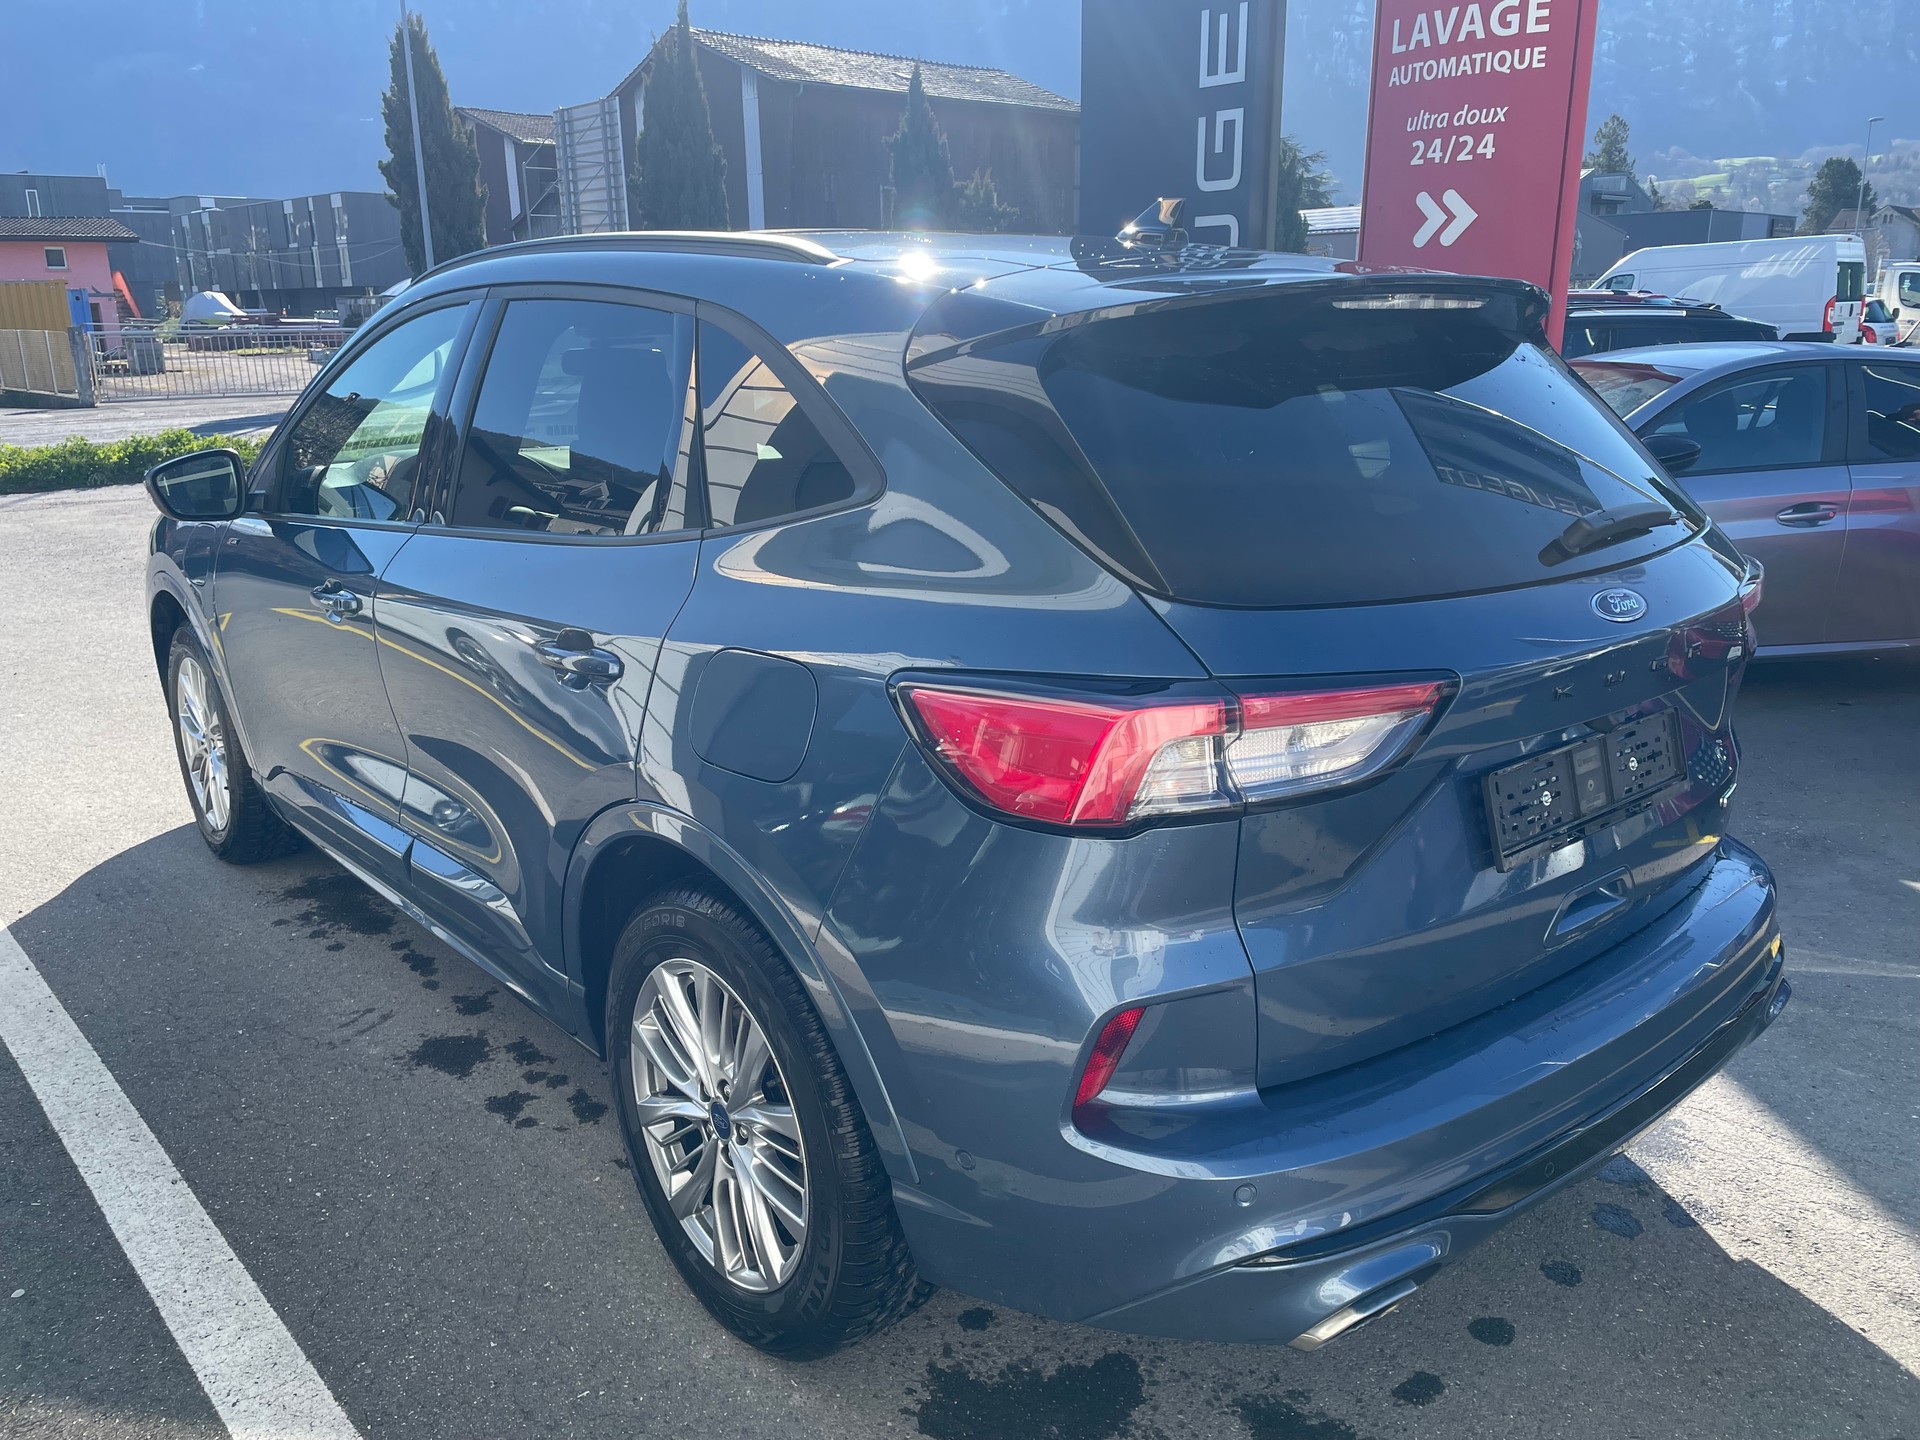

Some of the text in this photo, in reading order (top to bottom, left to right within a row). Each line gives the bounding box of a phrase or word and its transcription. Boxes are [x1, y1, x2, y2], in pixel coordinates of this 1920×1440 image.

[1391, 0, 1551, 54] LAVAGE
[1388, 46, 1547, 87] AUTOMATIQUE
[1406, 104, 1510, 132] ultra doux
[1410, 133, 1496, 166] 24/24
[1606, 592, 1640, 614] Ford
